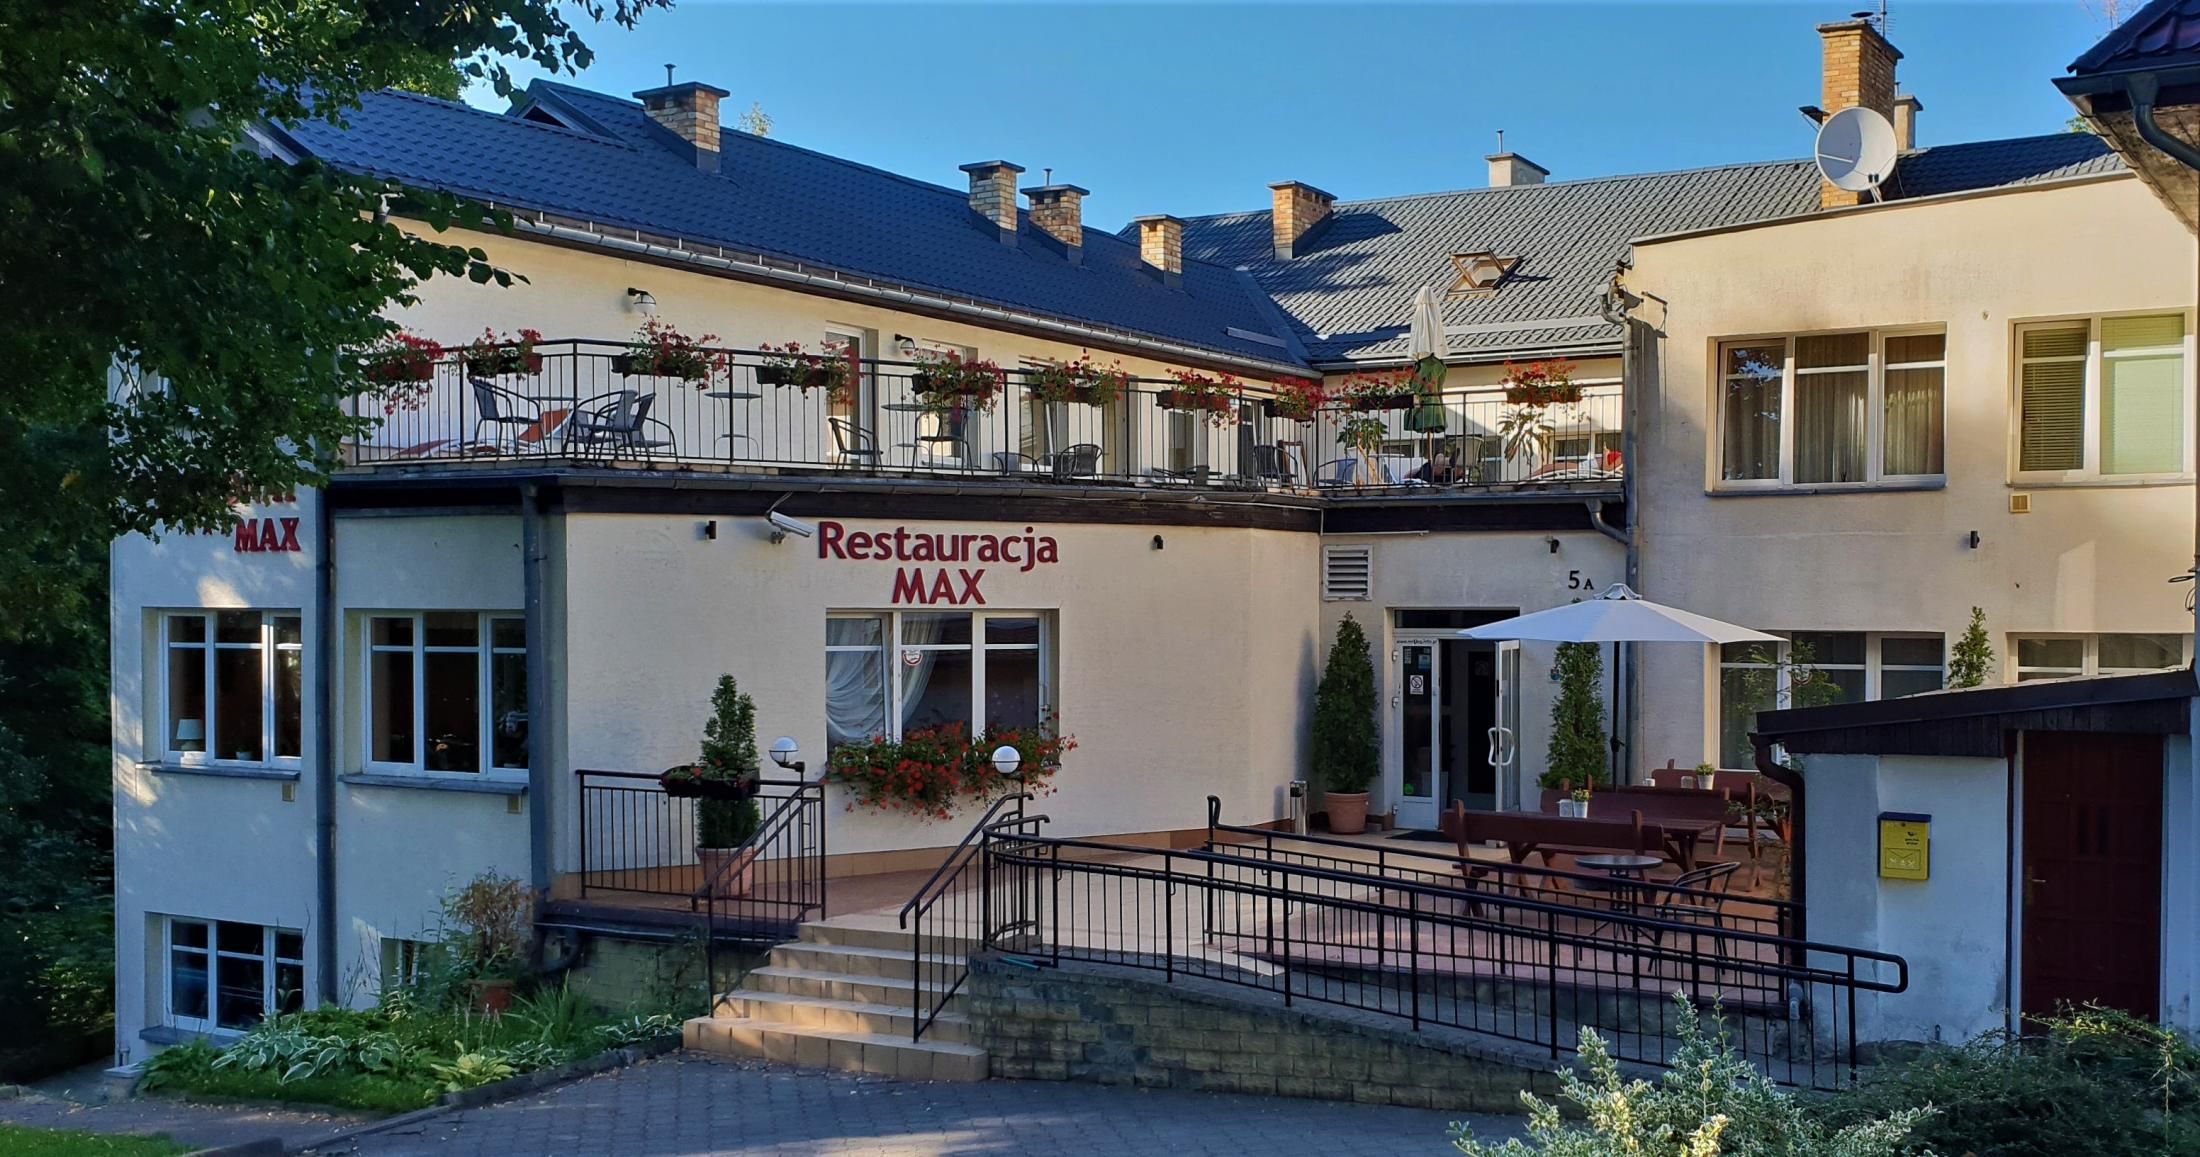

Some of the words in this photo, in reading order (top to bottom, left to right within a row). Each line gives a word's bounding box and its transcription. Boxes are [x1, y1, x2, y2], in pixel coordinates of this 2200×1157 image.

[234, 517, 302, 553] MAX
[818, 521, 1059, 572] Restauracja
[891, 567, 986, 605] MAX
